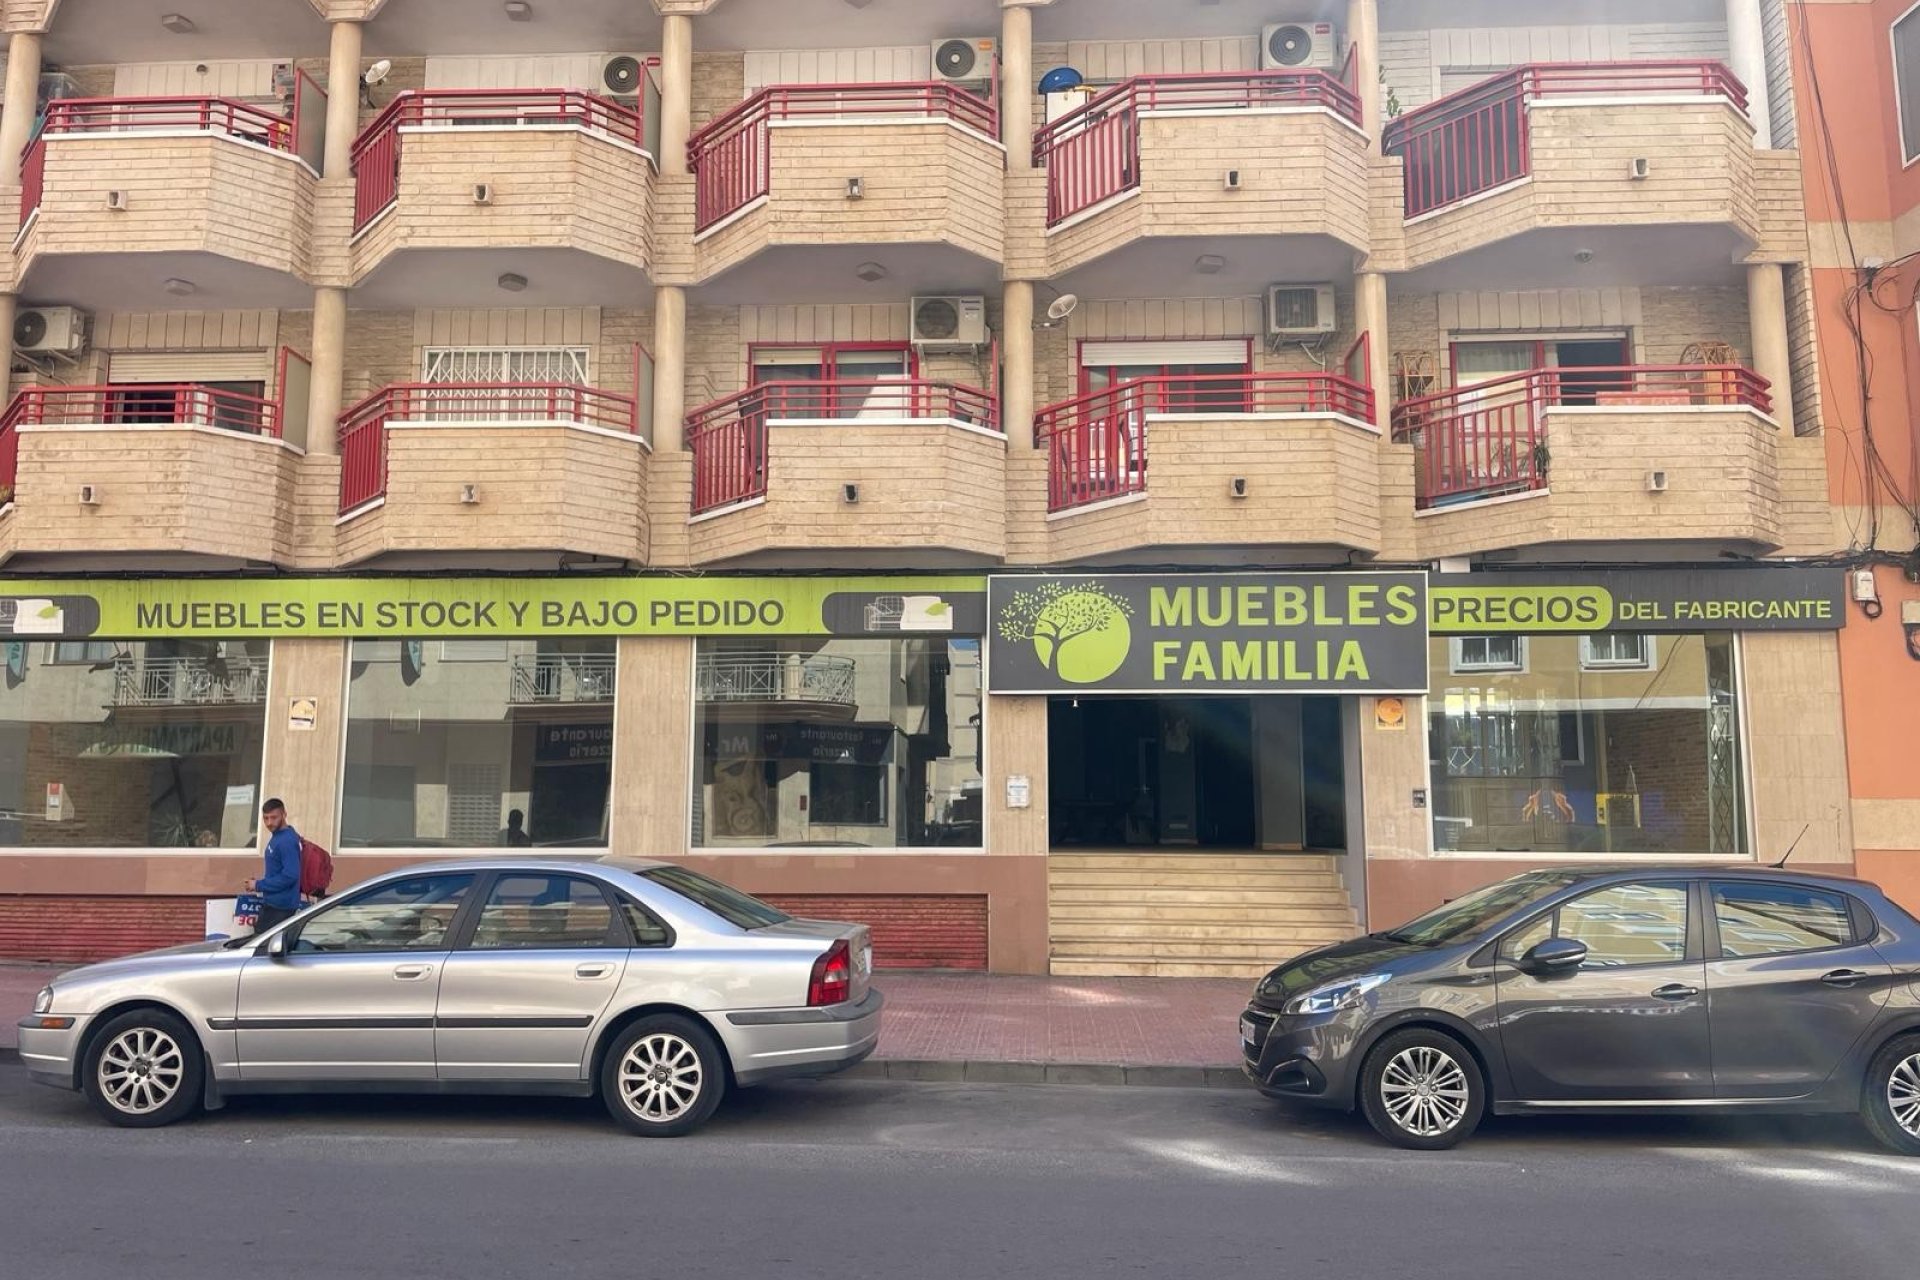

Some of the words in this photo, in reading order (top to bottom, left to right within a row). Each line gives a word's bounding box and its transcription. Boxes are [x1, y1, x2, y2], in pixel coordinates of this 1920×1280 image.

[136, 600, 306, 629] MUEBLES
[316, 601, 364, 628] EN
[376, 600, 497, 628] STOCK
[508, 600, 530, 627] Y
[541, 600, 638, 627] BAJO
[649, 599, 784, 627] PEDIDO
[1149, 585, 1418, 627] MUEBLES
[1432, 595, 1598, 624] PRECIOS
[1619, 602, 1668, 619] DEL
[1674, 600, 1832, 619] FABRICANTE
[1152, 639, 1371, 681] FAMILIA
